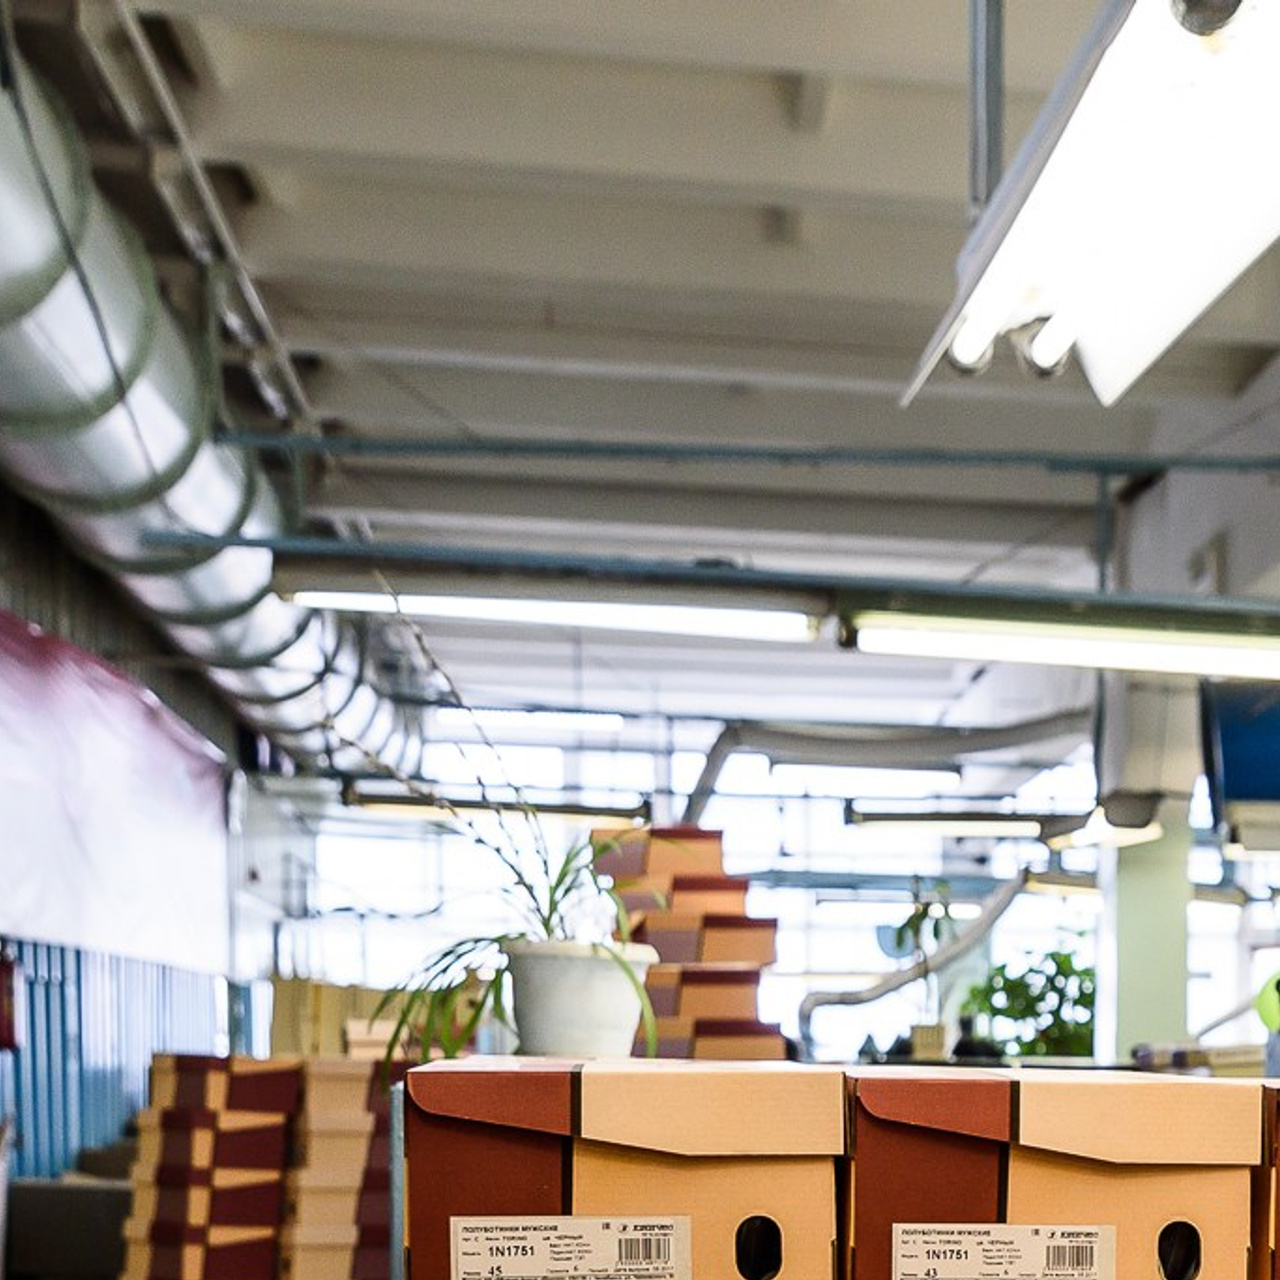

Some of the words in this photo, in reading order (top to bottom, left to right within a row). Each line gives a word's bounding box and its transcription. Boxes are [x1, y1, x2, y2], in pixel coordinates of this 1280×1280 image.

[488, 1245, 535, 1257] 1N1751
[925, 1248, 968, 1260] 1N1751
[487, 1265, 502, 1276] 45
[924, 1267, 937, 1278] 43
